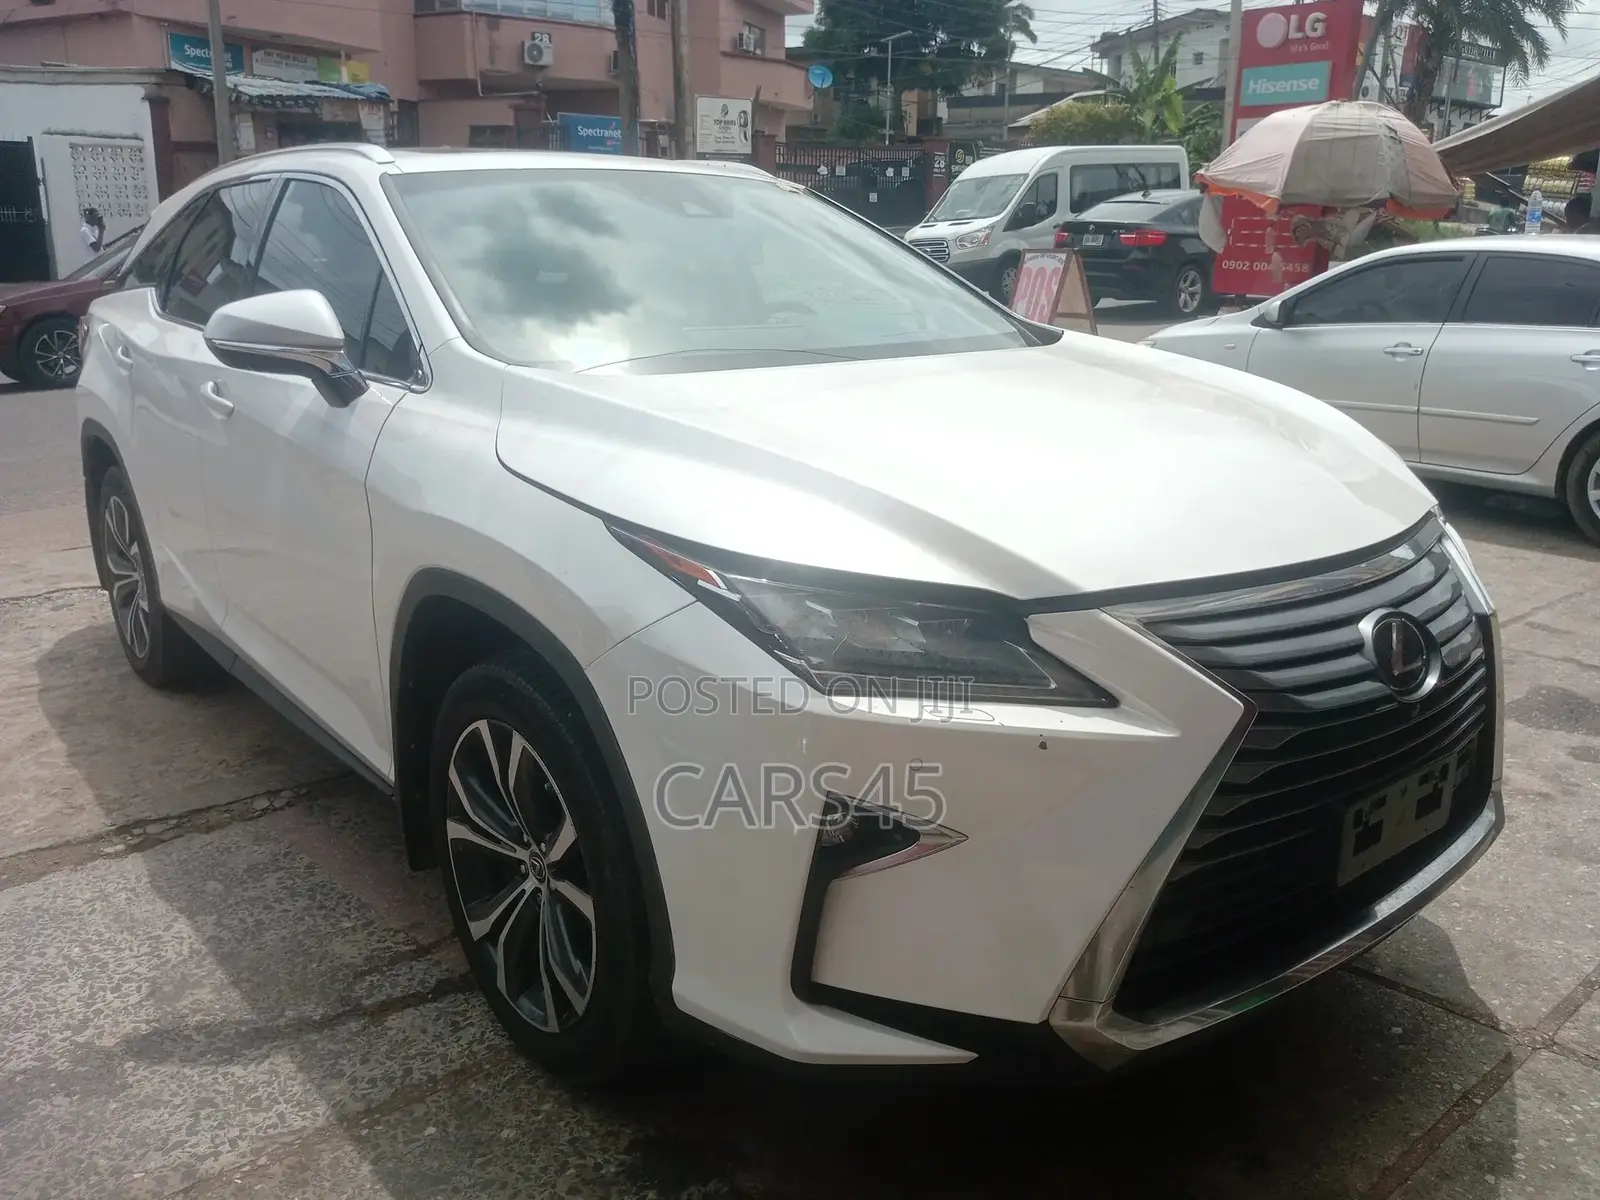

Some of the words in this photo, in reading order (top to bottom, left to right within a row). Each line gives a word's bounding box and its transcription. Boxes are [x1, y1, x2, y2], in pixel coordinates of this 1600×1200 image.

[1288, 12, 1327, 39] LG
[534, 32, 550, 44] 28
[184, 44, 232, 61] Spectet
[1248, 77, 1320, 94] Hisense
[577, 125, 622, 138] Spectranet
[934, 155, 946, 168] 28
[1222, 260, 1250, 271] 0902
